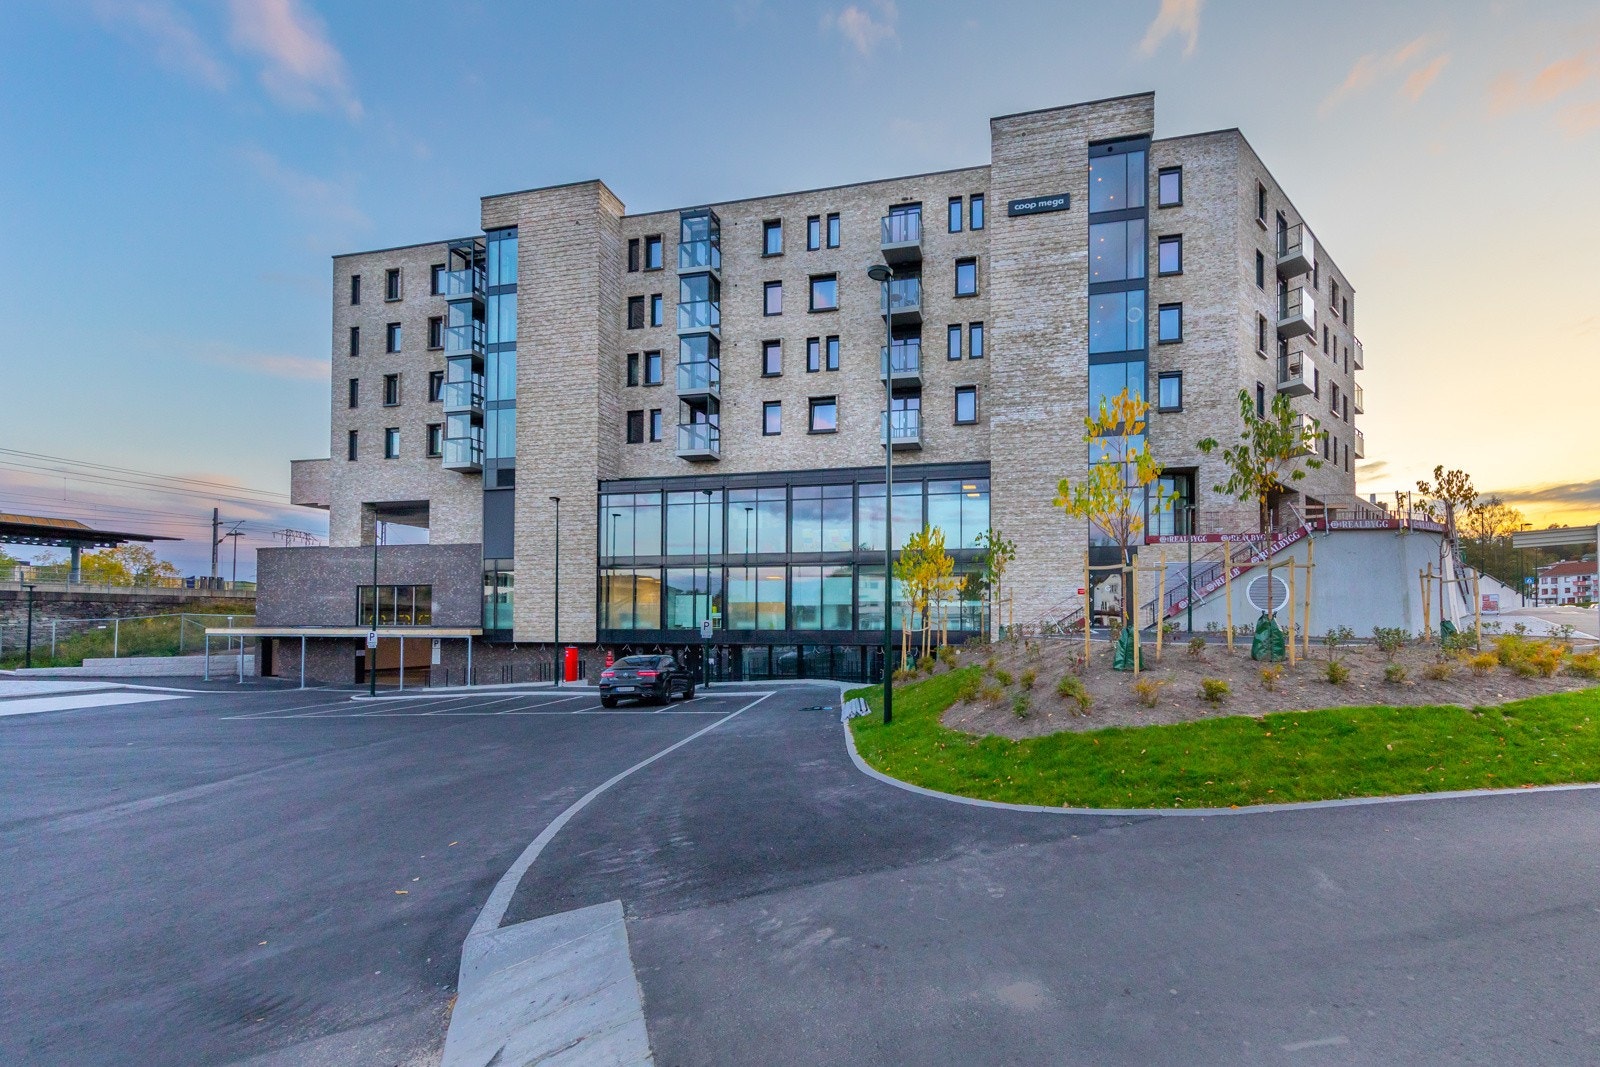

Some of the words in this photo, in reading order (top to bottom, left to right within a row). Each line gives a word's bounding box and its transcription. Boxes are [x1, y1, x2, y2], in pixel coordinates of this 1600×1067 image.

[1014, 202, 1037, 210] coop
[1038, 198, 1064, 207] mega
[1342, 520, 1389, 529] REALBYGG
[1231, 533, 1267, 542] REALBYG
[704, 621, 710, 630] P
[369, 632, 375, 641] P
